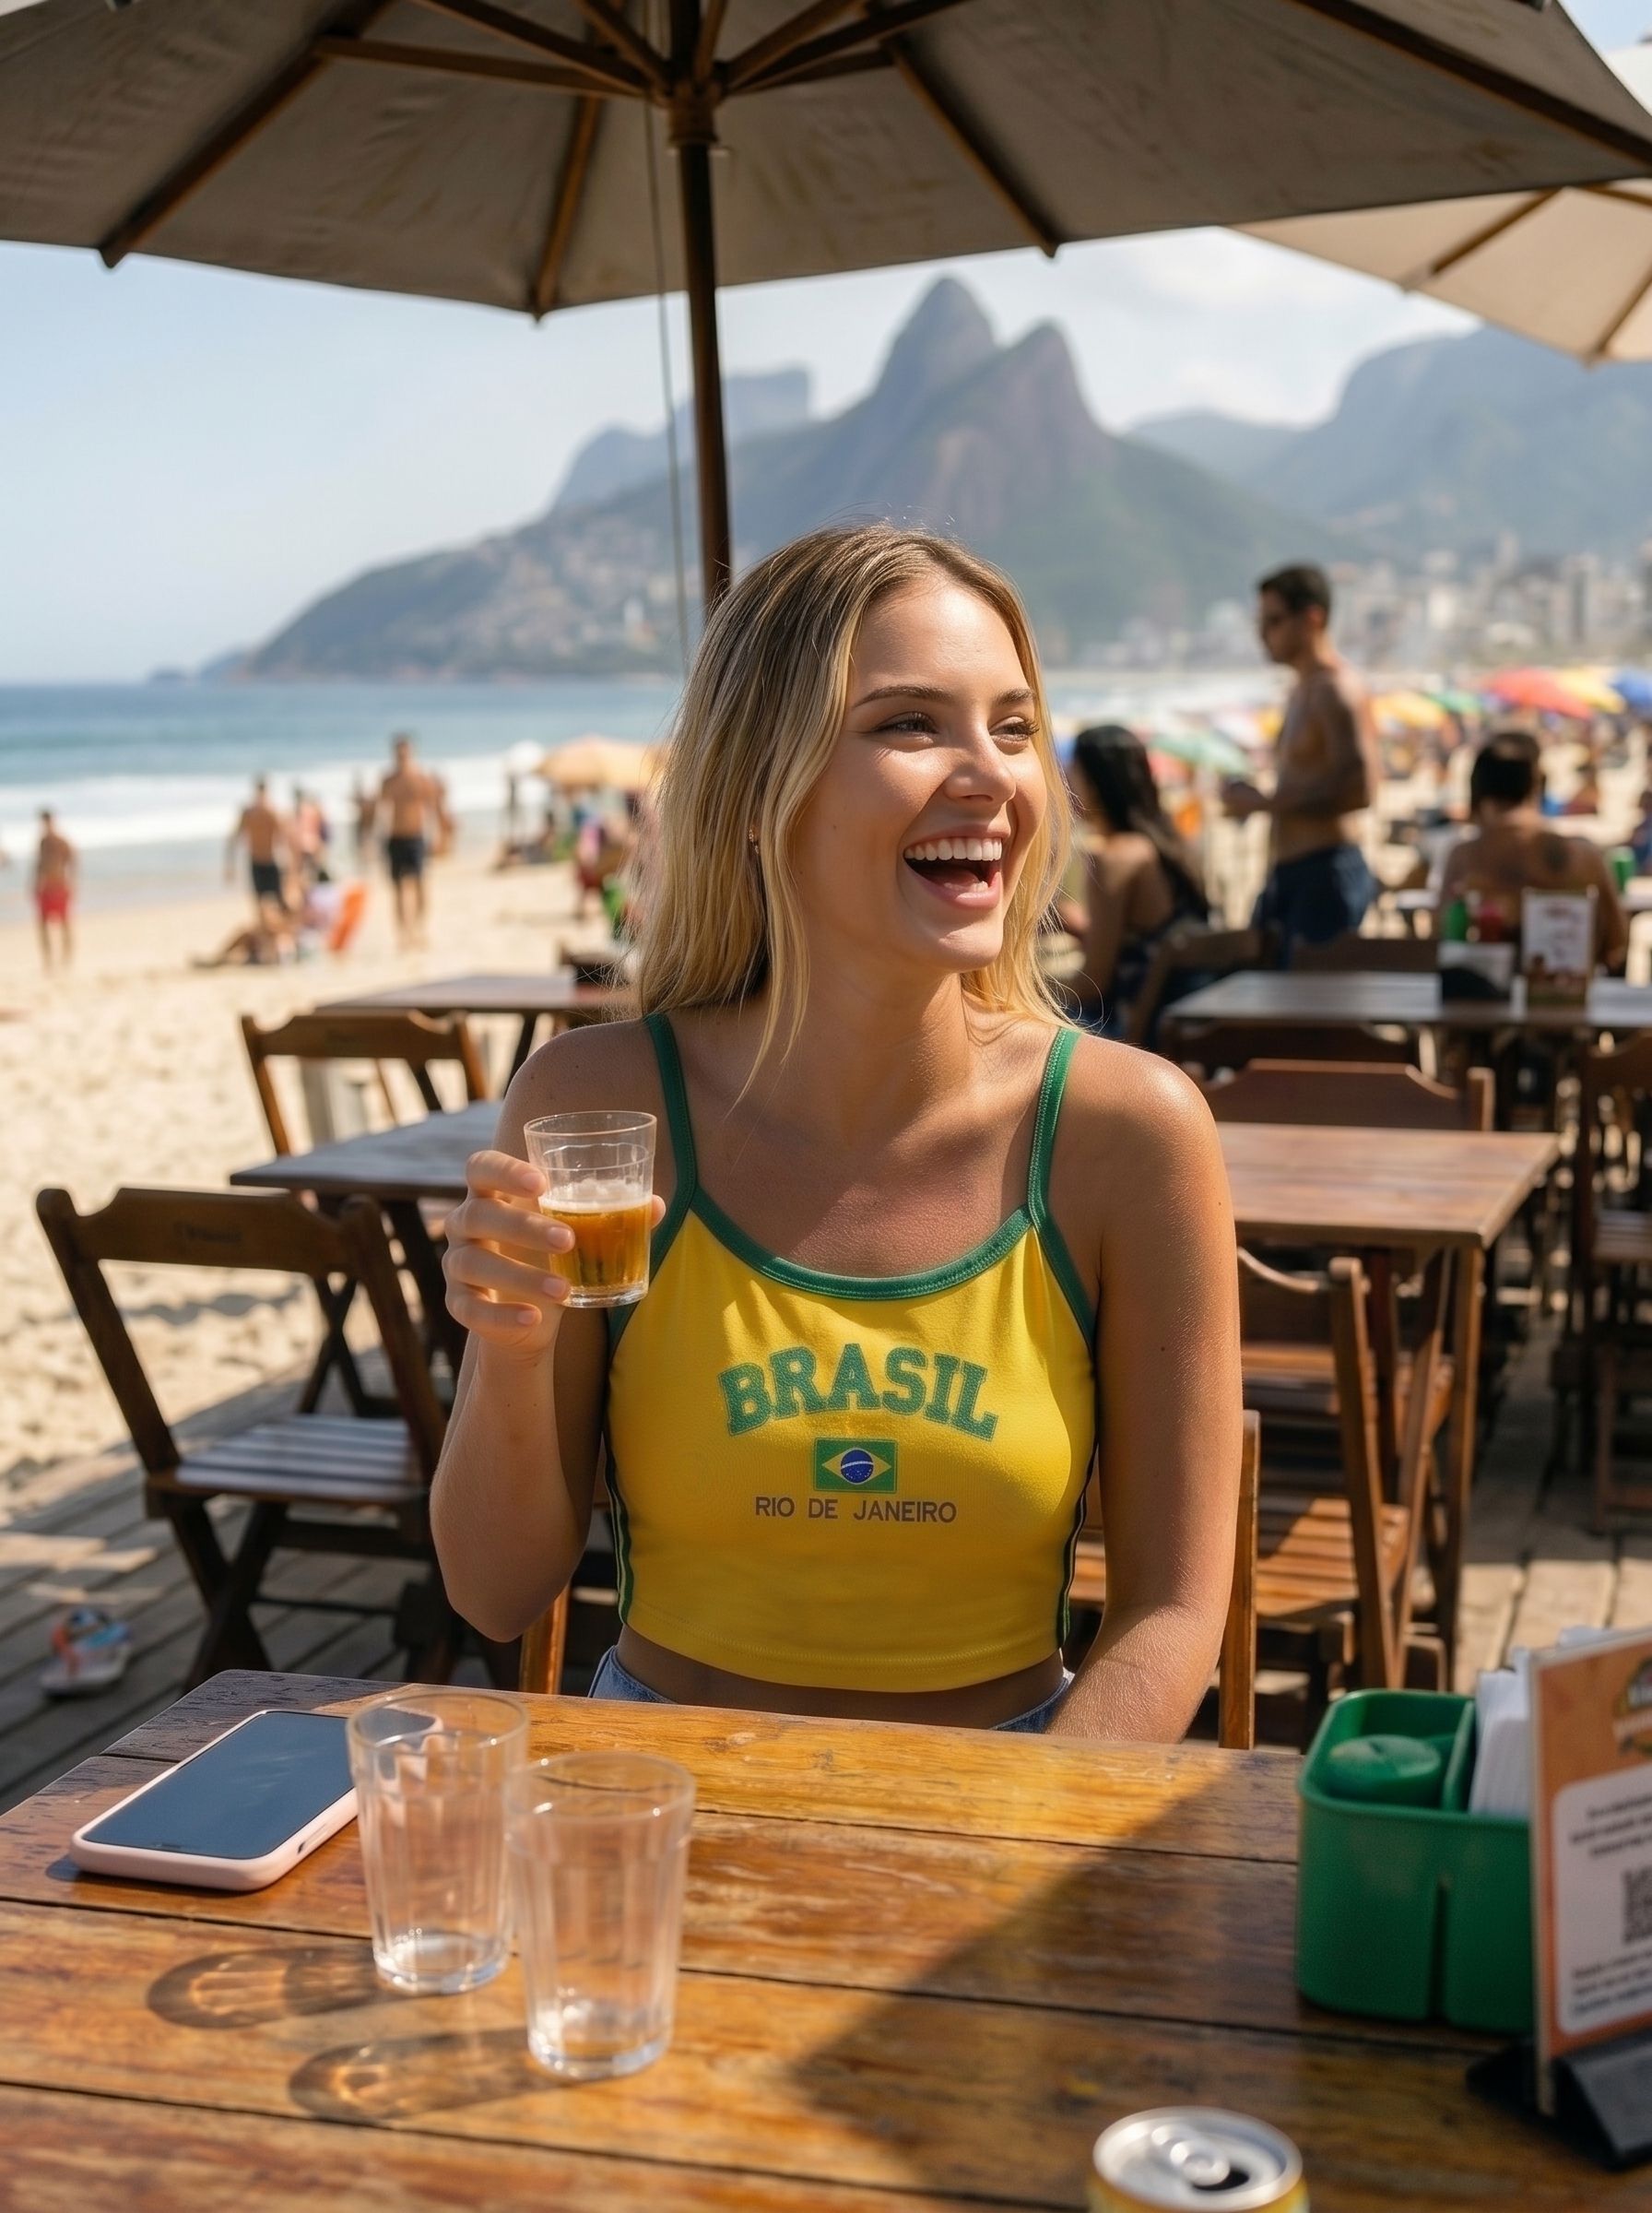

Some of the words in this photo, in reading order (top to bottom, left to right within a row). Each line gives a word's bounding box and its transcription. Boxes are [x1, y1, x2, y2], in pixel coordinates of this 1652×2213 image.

[718, 1343, 999, 1441] BRASIL
[754, 1497, 796, 1518] RIO
[808, 1498, 839, 1520] DE
[853, 1500, 958, 1523] JANEIRO
